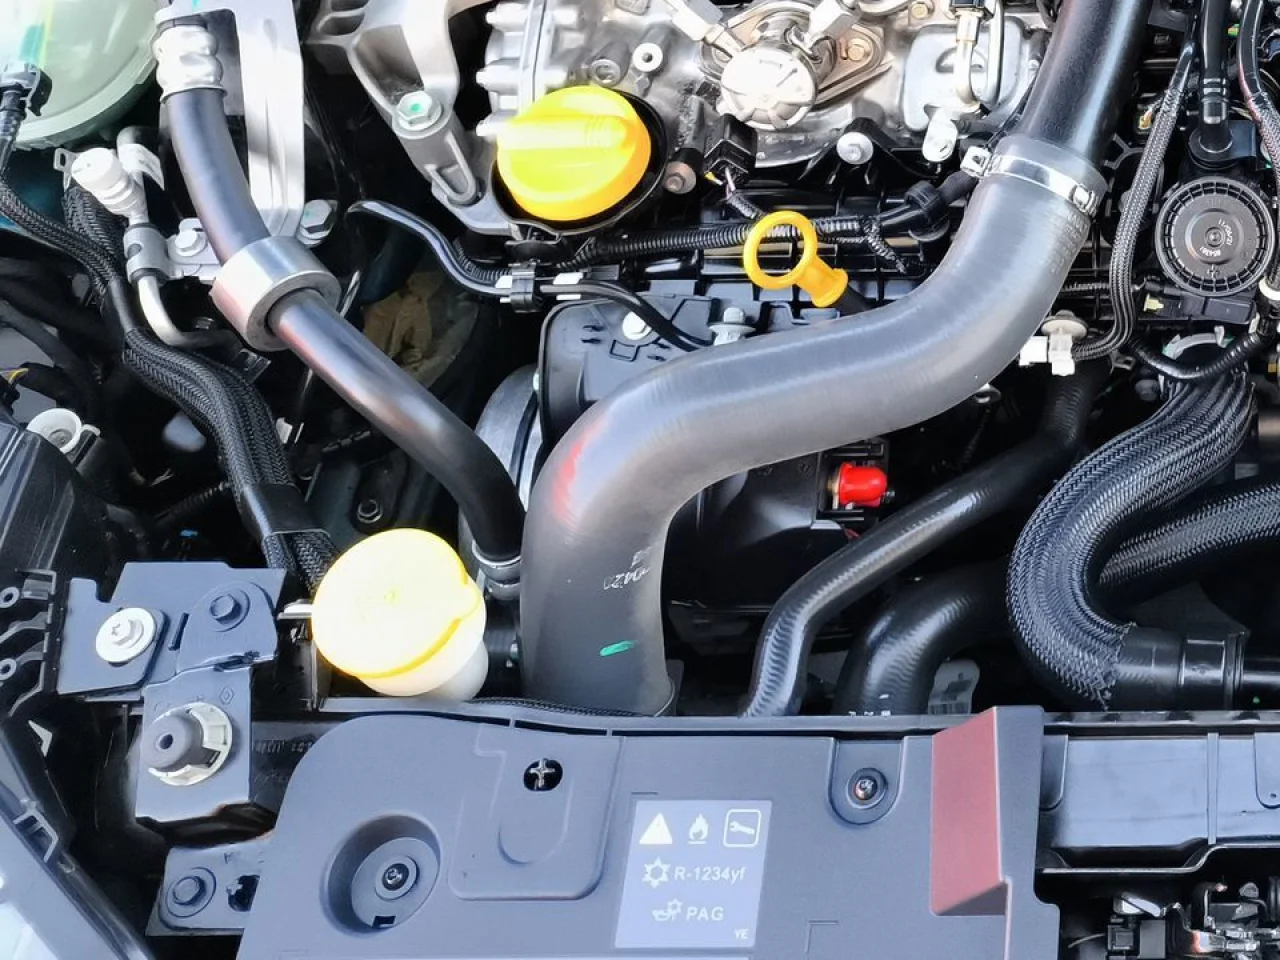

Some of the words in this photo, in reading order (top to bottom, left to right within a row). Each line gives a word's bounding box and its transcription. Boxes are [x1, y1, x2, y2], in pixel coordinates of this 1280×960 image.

[674, 866, 747, 884] R-1234yf
[686, 906, 724, 921] PAG
[734, 929, 749, 940] YE
